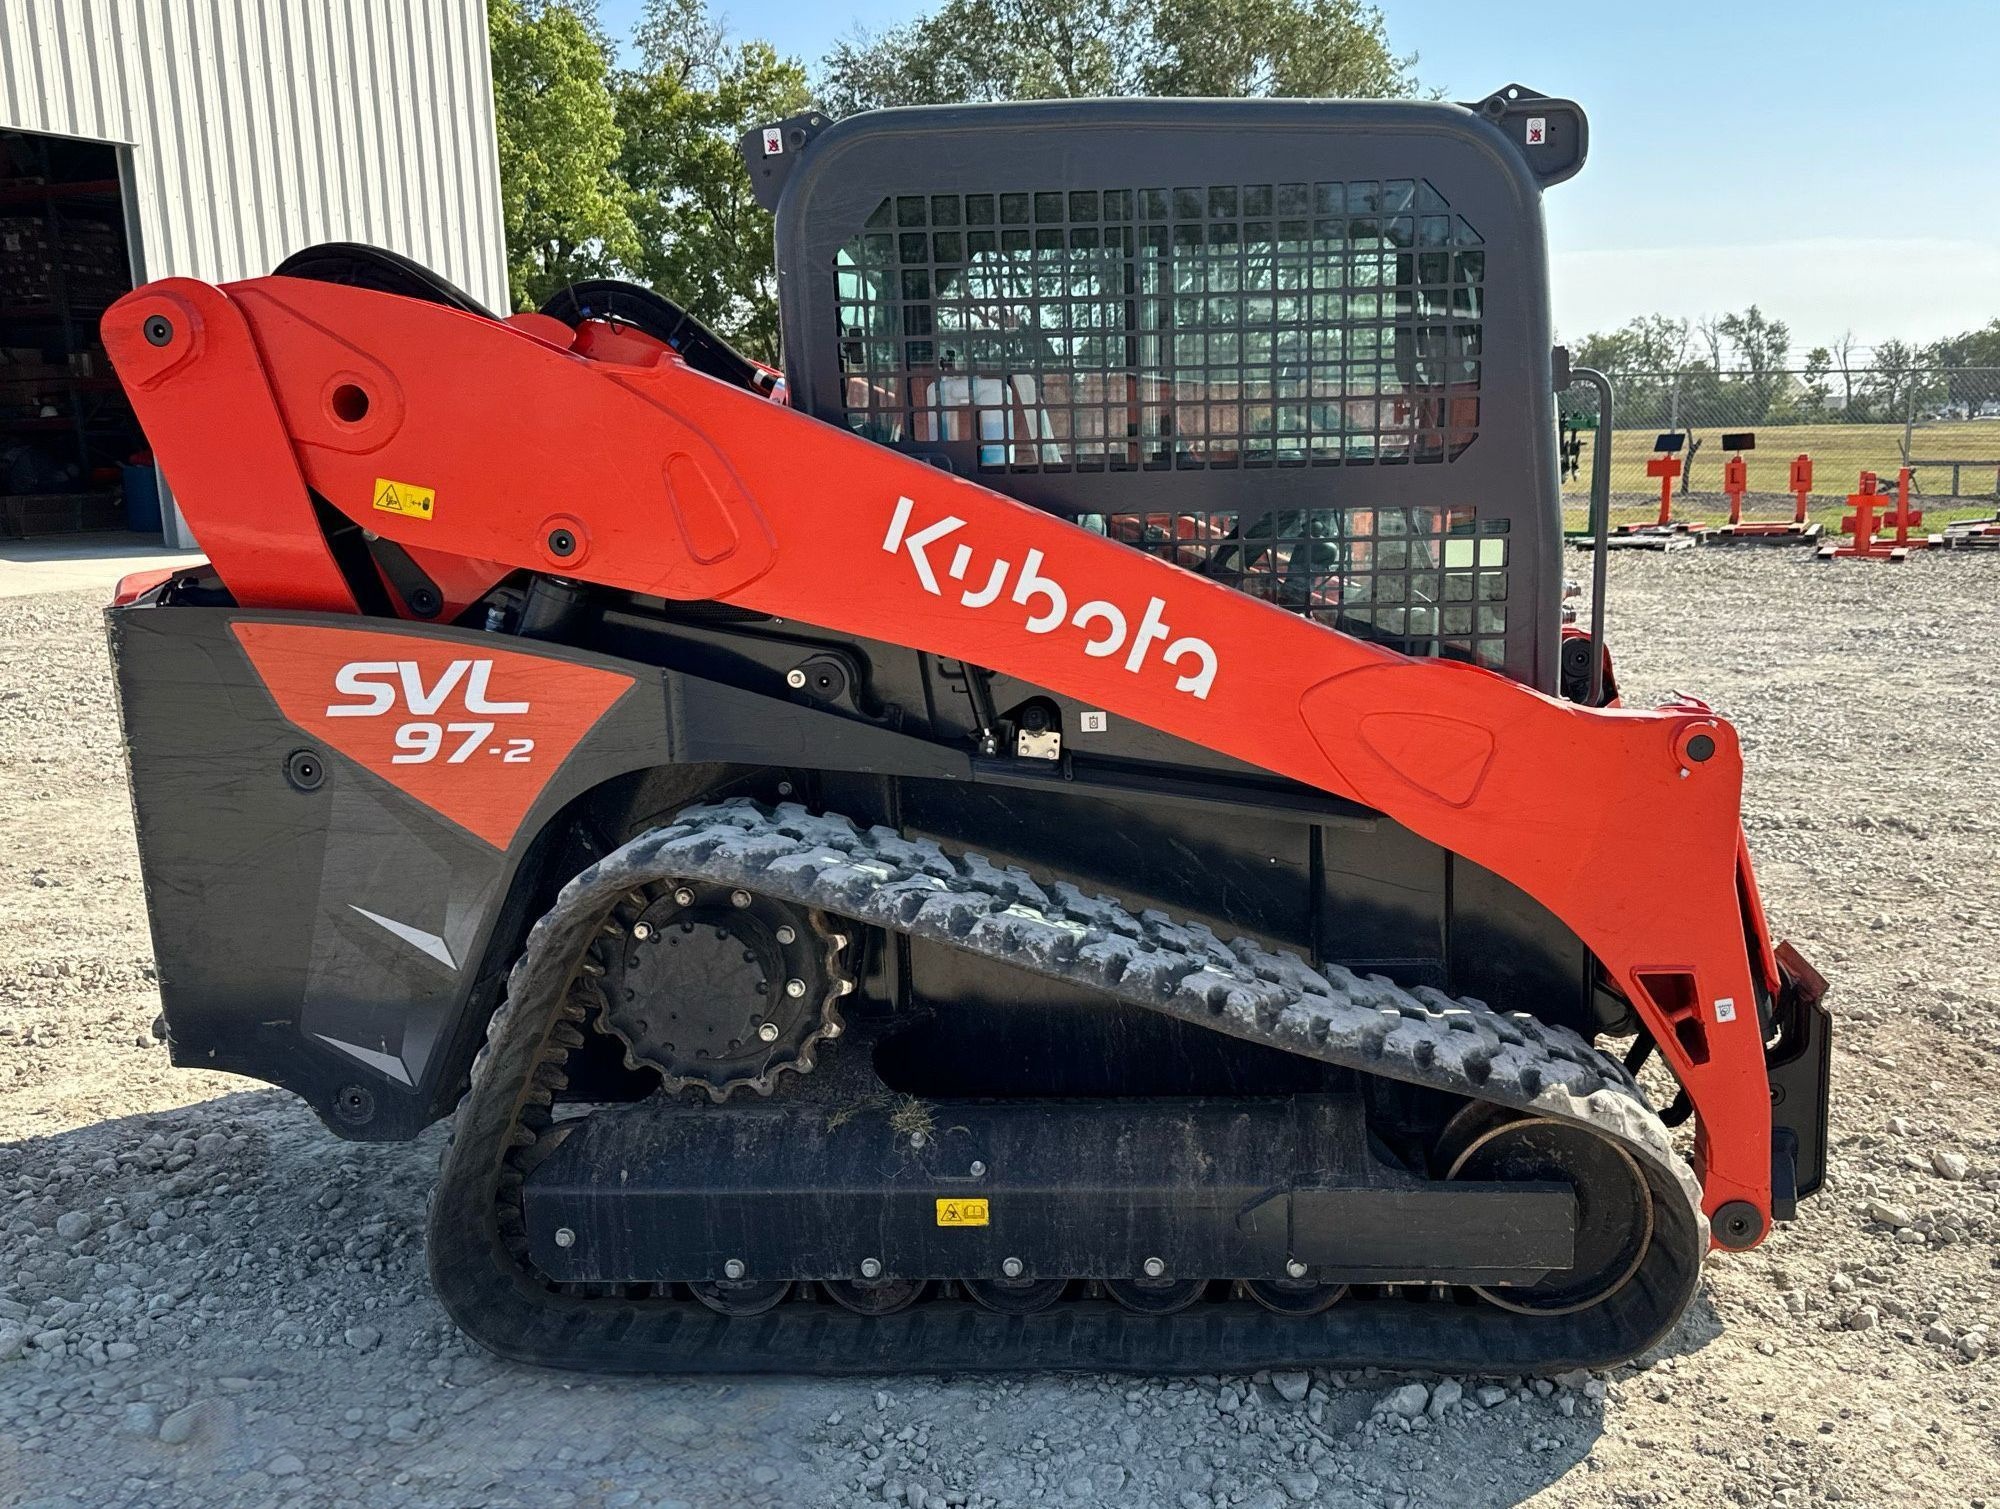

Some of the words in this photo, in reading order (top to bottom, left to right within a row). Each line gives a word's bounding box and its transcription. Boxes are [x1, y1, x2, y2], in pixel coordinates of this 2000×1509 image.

[883, 496, 1218, 700] Kubota
[326, 660, 530, 717] SVL
[392, 722, 535, 764] 97-2
